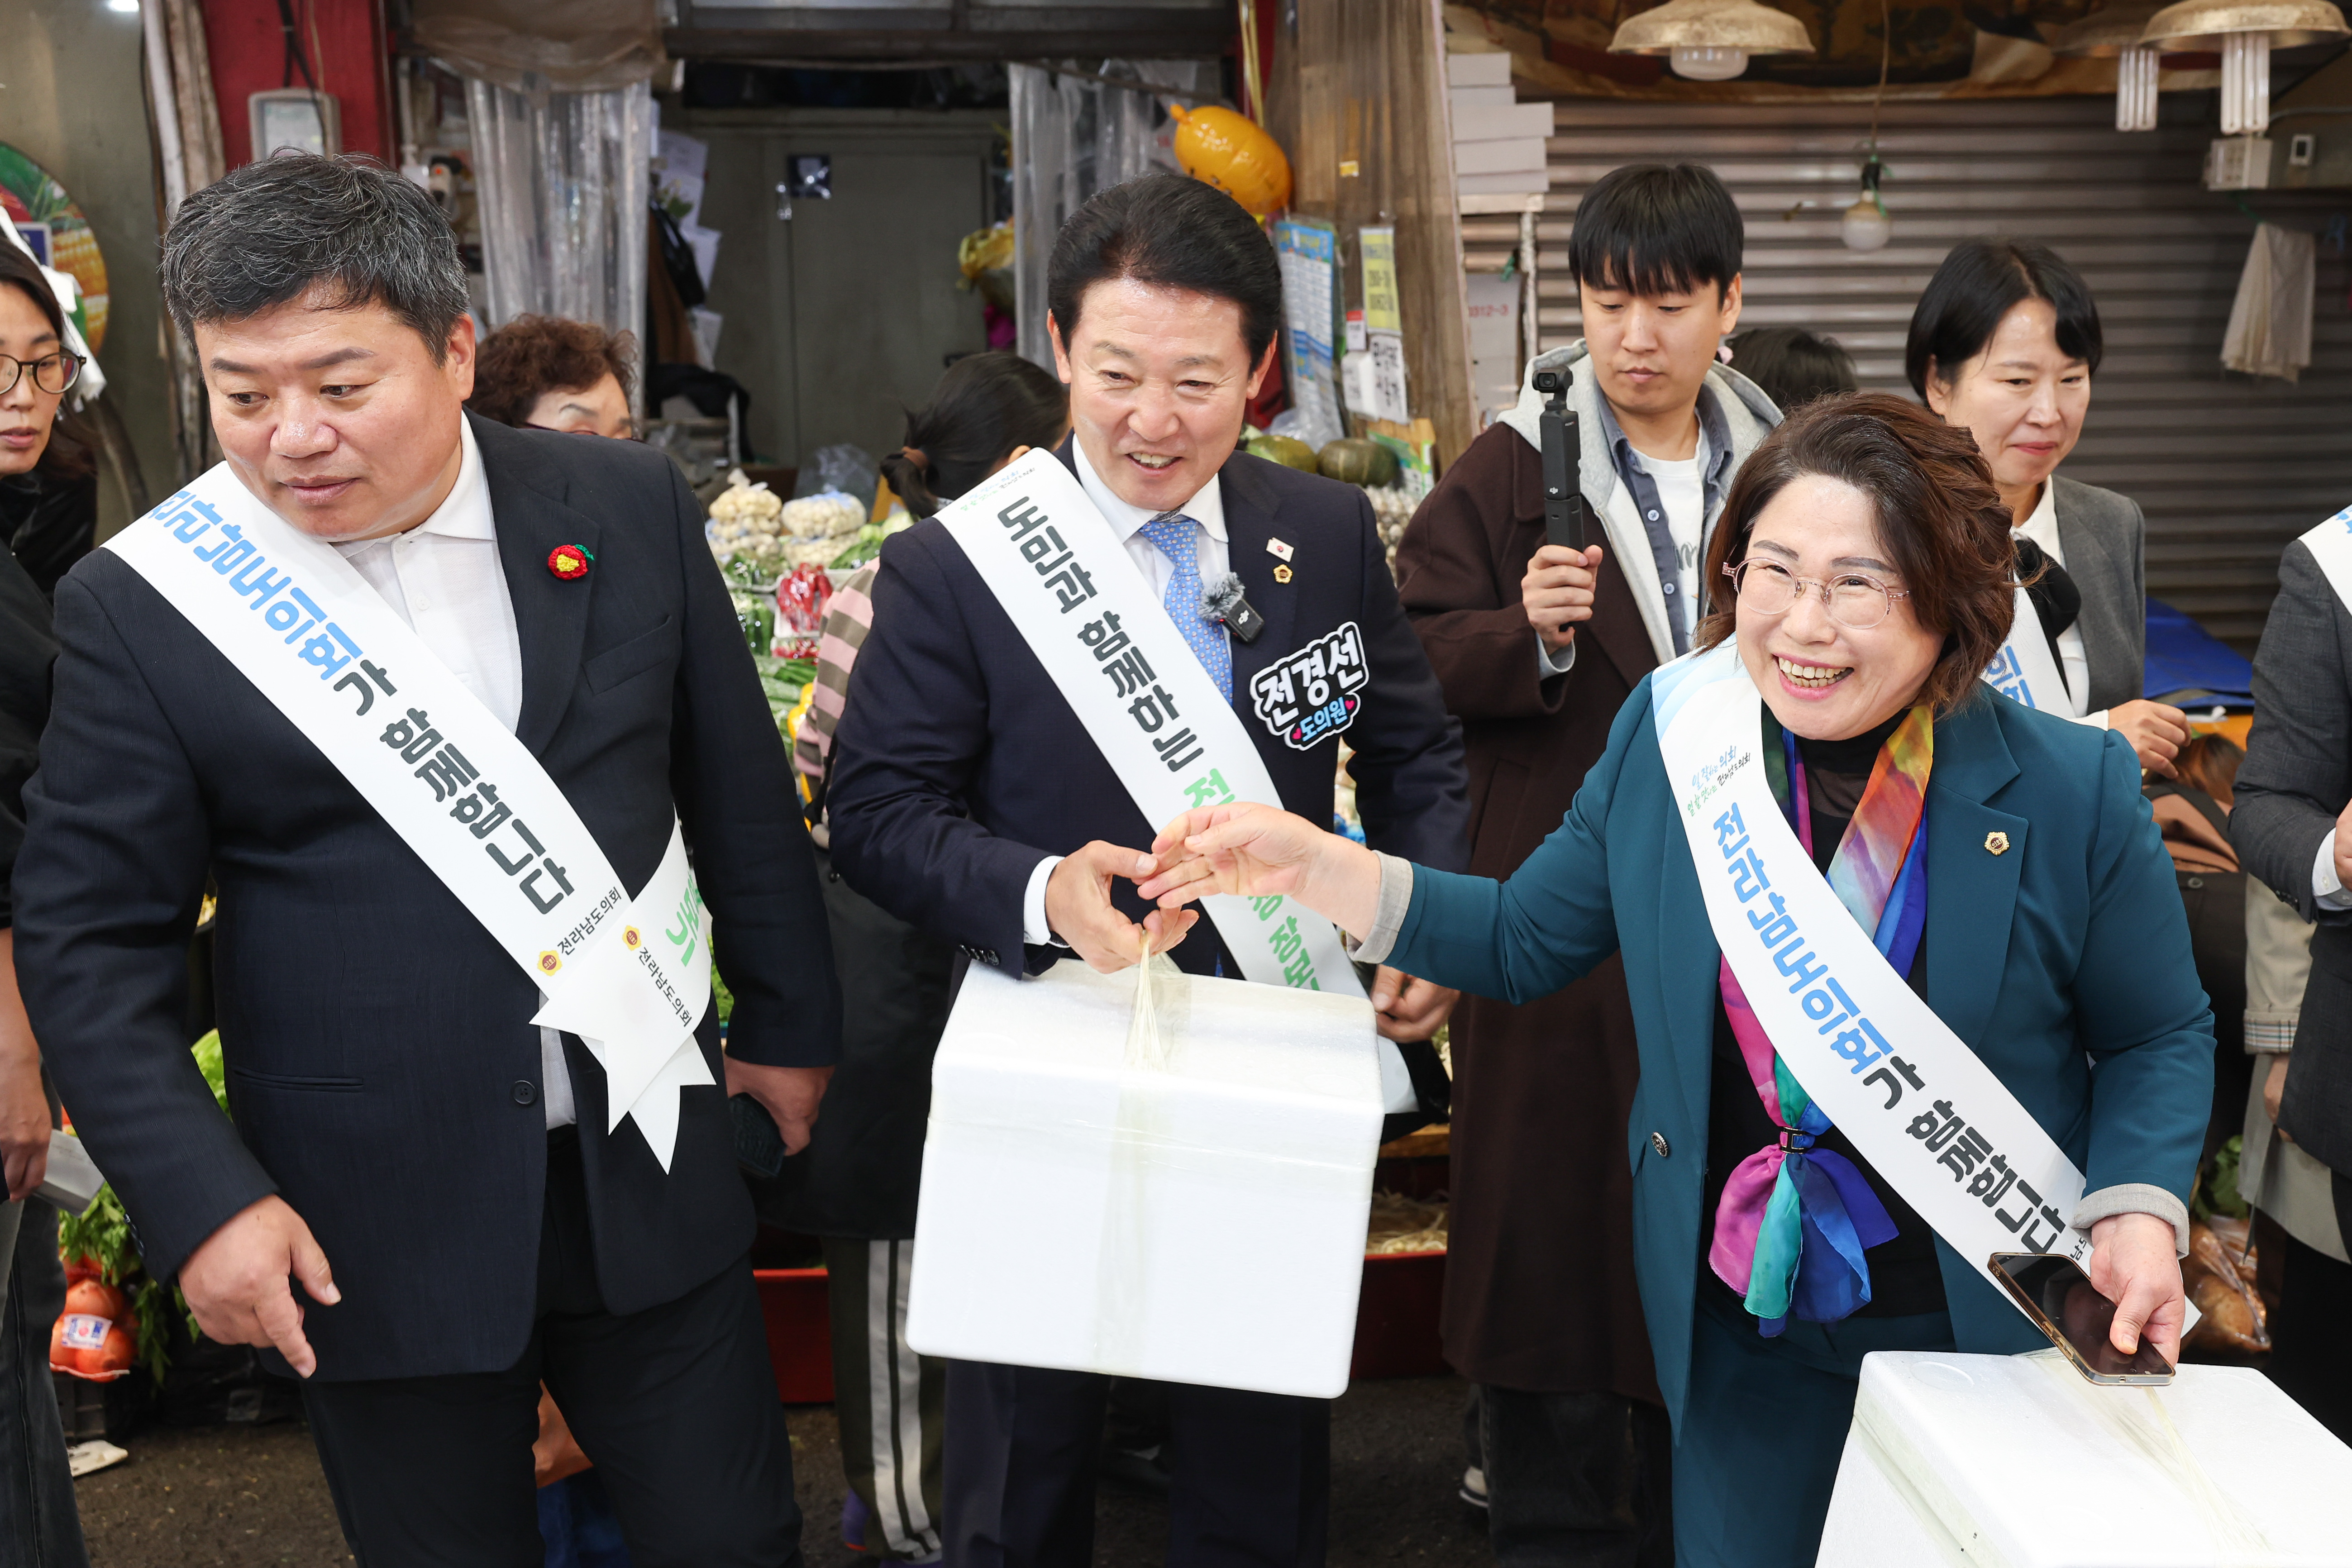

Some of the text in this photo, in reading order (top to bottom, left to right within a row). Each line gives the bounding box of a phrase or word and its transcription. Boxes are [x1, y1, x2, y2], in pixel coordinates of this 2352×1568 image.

[997, 496, 1097, 614] 도민과
[1078, 610, 1204, 772] 함께하는
[1258, 630, 1363, 727] 전경선
[1299, 696, 1348, 742] 도의원
[379, 708, 575, 915] 함께합니다
[1692, 772, 1704, 791] 일
[1720, 745, 1736, 767] 의회
[1717, 752, 1751, 786] 전라남도의회
[544, 886, 622, 969] 의회 전라남도의회
[628, 932, 692, 1028] 의회 전라남도의회
[1713, 802, 2066, 1254] 전라남도의회가 함께합니다
